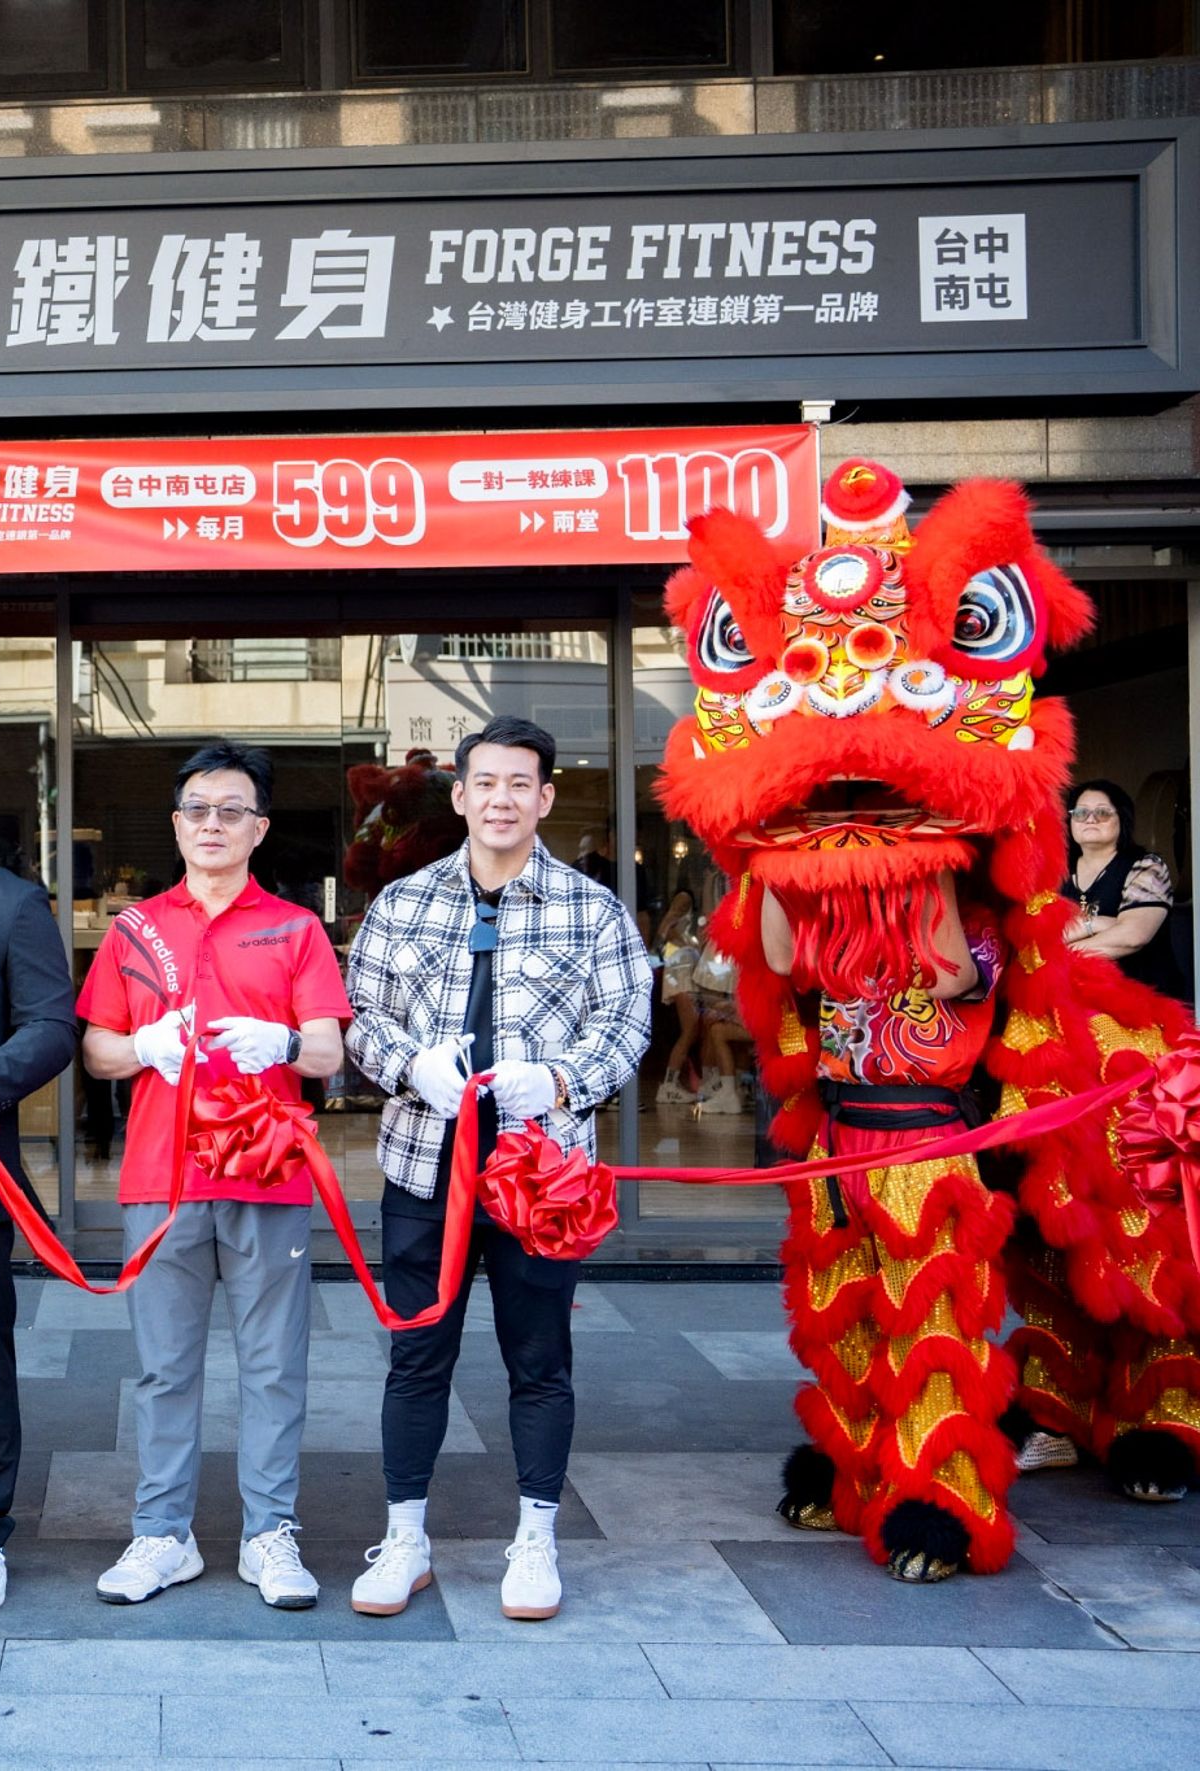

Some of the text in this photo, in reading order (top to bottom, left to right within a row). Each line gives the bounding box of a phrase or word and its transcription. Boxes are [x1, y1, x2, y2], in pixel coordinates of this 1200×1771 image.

[425, 219, 877, 284] FORGE FITNESS
[934, 226, 1011, 267] 台中
[467, 291, 879, 332] 台灣健身工作室連鎖第一品牌
[934, 273, 1013, 311] 南屯
[111, 473, 246, 499] 台中南屯店
[459, 468, 597, 490] 一對一教練課
[617, 449, 789, 541] 1100
[273, 458, 426, 547] 599
[195, 515, 244, 541] 每月
[252, 937, 289, 947] adidas
[152, 938, 180, 993] adidas
